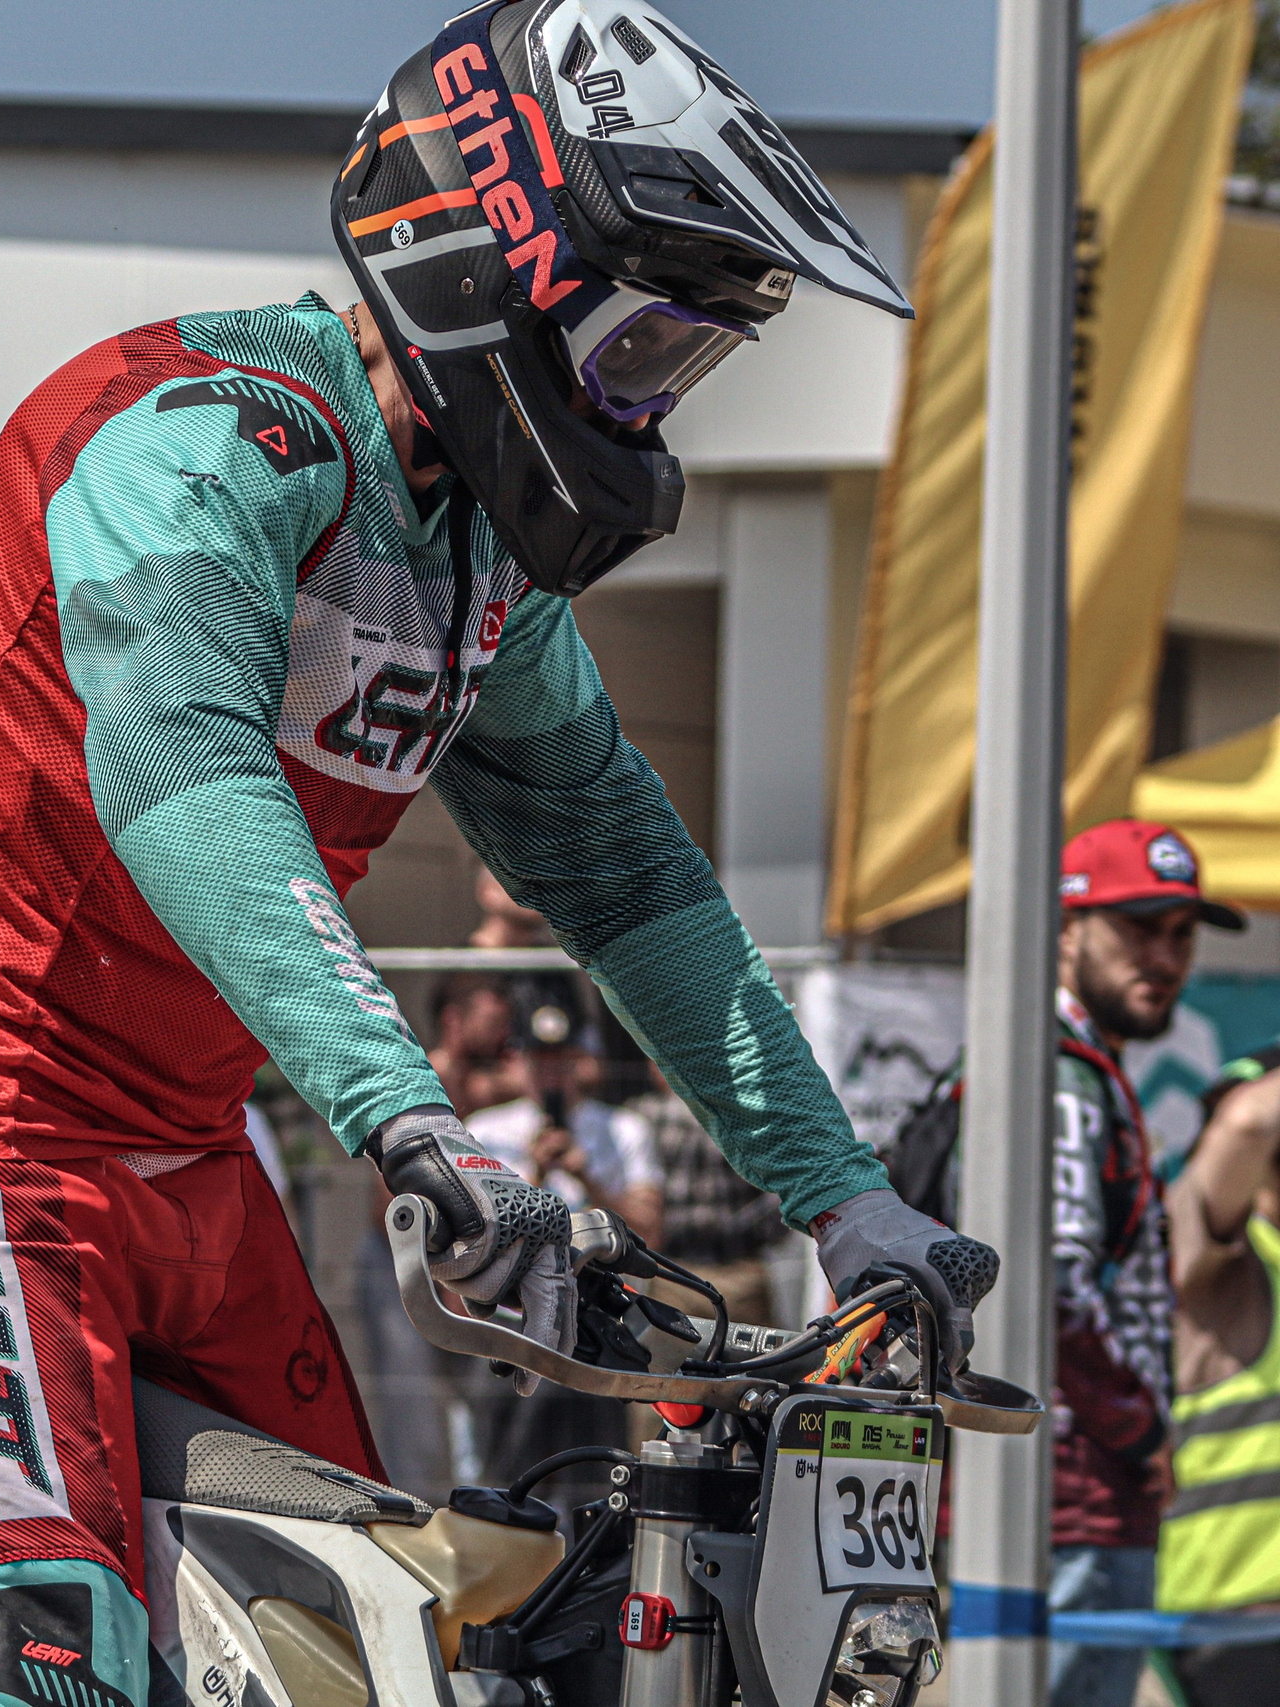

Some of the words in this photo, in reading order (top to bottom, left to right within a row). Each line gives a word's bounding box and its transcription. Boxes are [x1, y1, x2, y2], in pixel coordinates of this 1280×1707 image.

[576, 69, 636, 140] 04
[394, 221, 411, 246] 369
[416, 355, 435, 385] EMERGENCY
[431, 384, 440, 395] USE
[436, 394, 447, 408] ONLY
[485, 353, 503, 382] MOTO
[507, 398, 532, 440] CARBON
[830, 1442, 851, 1450] ENDURO
[836, 1475, 926, 1571] 369
[630, 1611, 640, 1631] 369
[21, 1640, 82, 1667] LEATT
